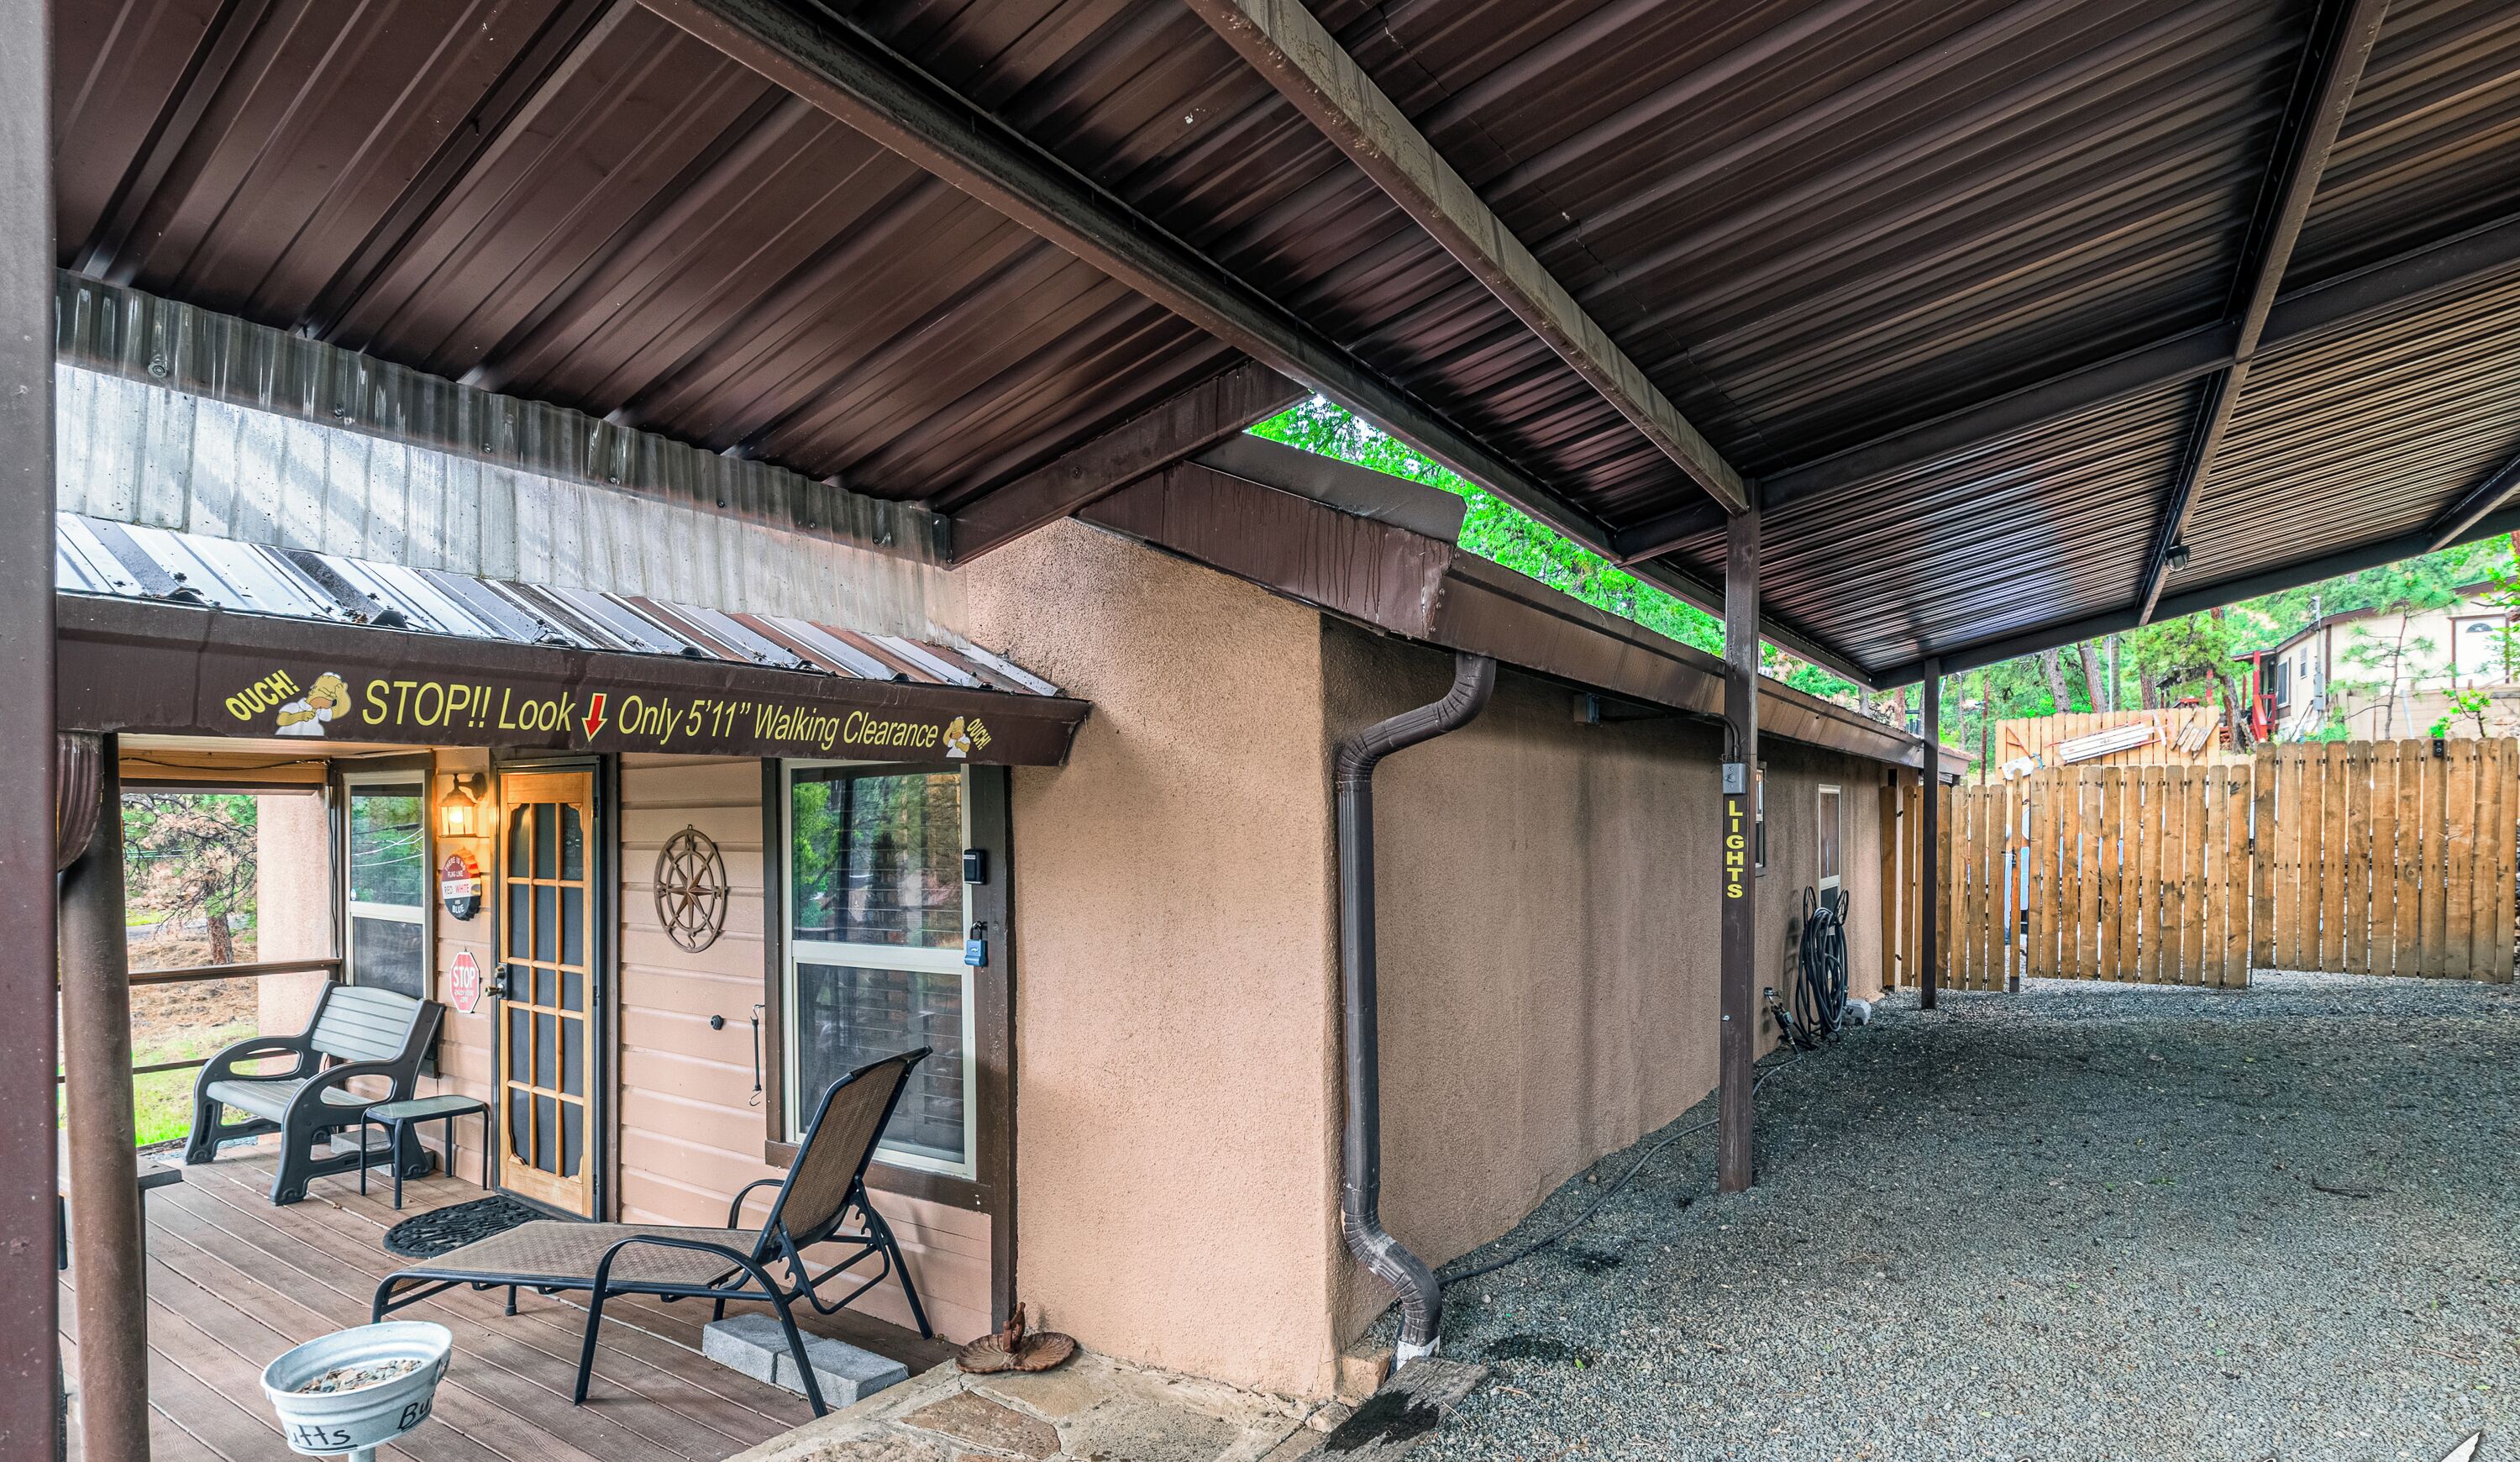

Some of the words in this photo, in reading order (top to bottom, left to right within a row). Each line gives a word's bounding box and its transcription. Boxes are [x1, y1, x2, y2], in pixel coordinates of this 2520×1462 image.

[225, 669, 301, 721] OUCH!
[362, 679, 491, 728] STOP!!
[498, 687, 575, 732] Look
[618, 695, 683, 745] Only
[754, 703, 840, 751] Walking
[843, 710, 938, 748] Clearance
[967, 718, 991, 750] OUCH!
[1726, 800, 1745, 898] LIGHTS
[452, 903, 465, 914] BLUE
[453, 965, 475, 988] STOP
[396, 1392, 434, 1430] Bu
[287, 1424, 351, 1446] utts
